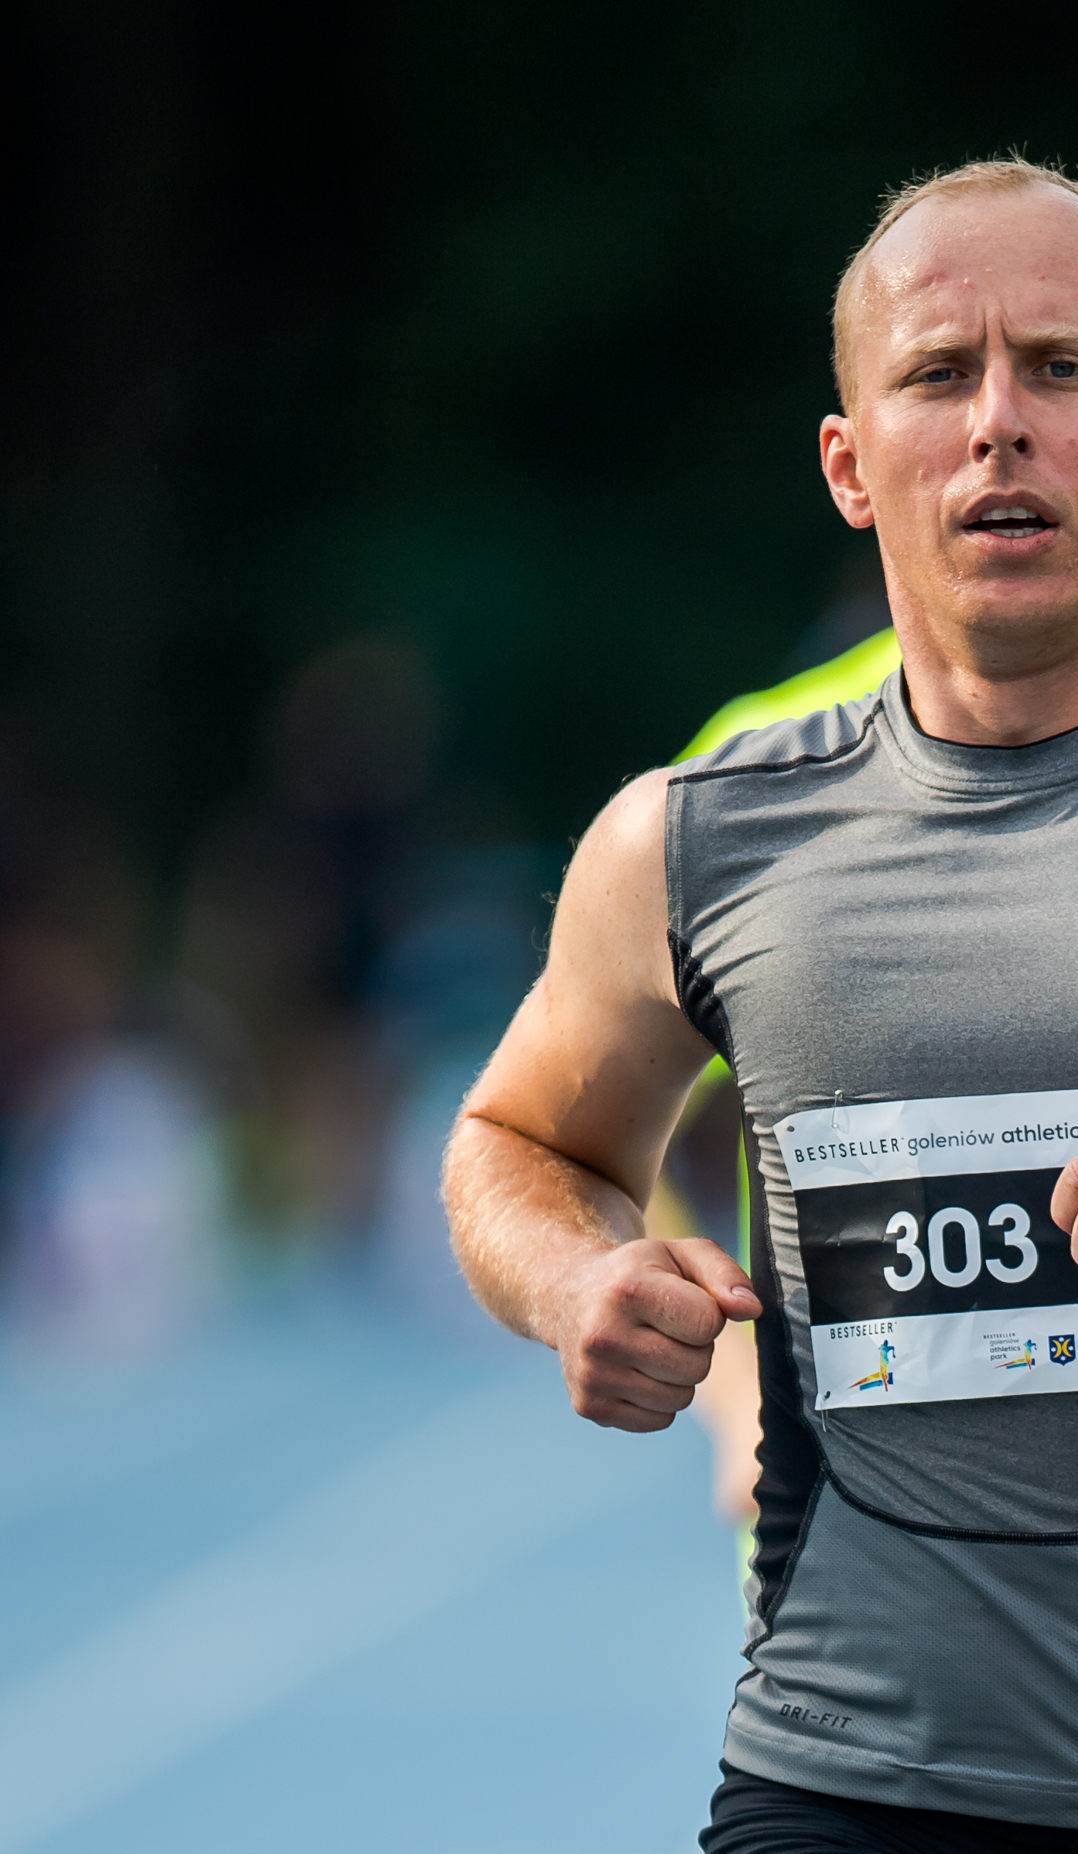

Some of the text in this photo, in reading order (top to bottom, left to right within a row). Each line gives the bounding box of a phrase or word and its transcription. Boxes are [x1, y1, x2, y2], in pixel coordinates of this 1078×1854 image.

[794, 1137, 900, 1163] BESTSELLER
[907, 1130, 995, 1157] goleniów
[883, 1202, 1039, 1292] 303
[830, 1321, 894, 1340] BESTSELLER
[989, 1345, 1021, 1354] athletics
[990, 1353, 1007, 1361] park
[779, 1703, 852, 1729] DRI-FIT
